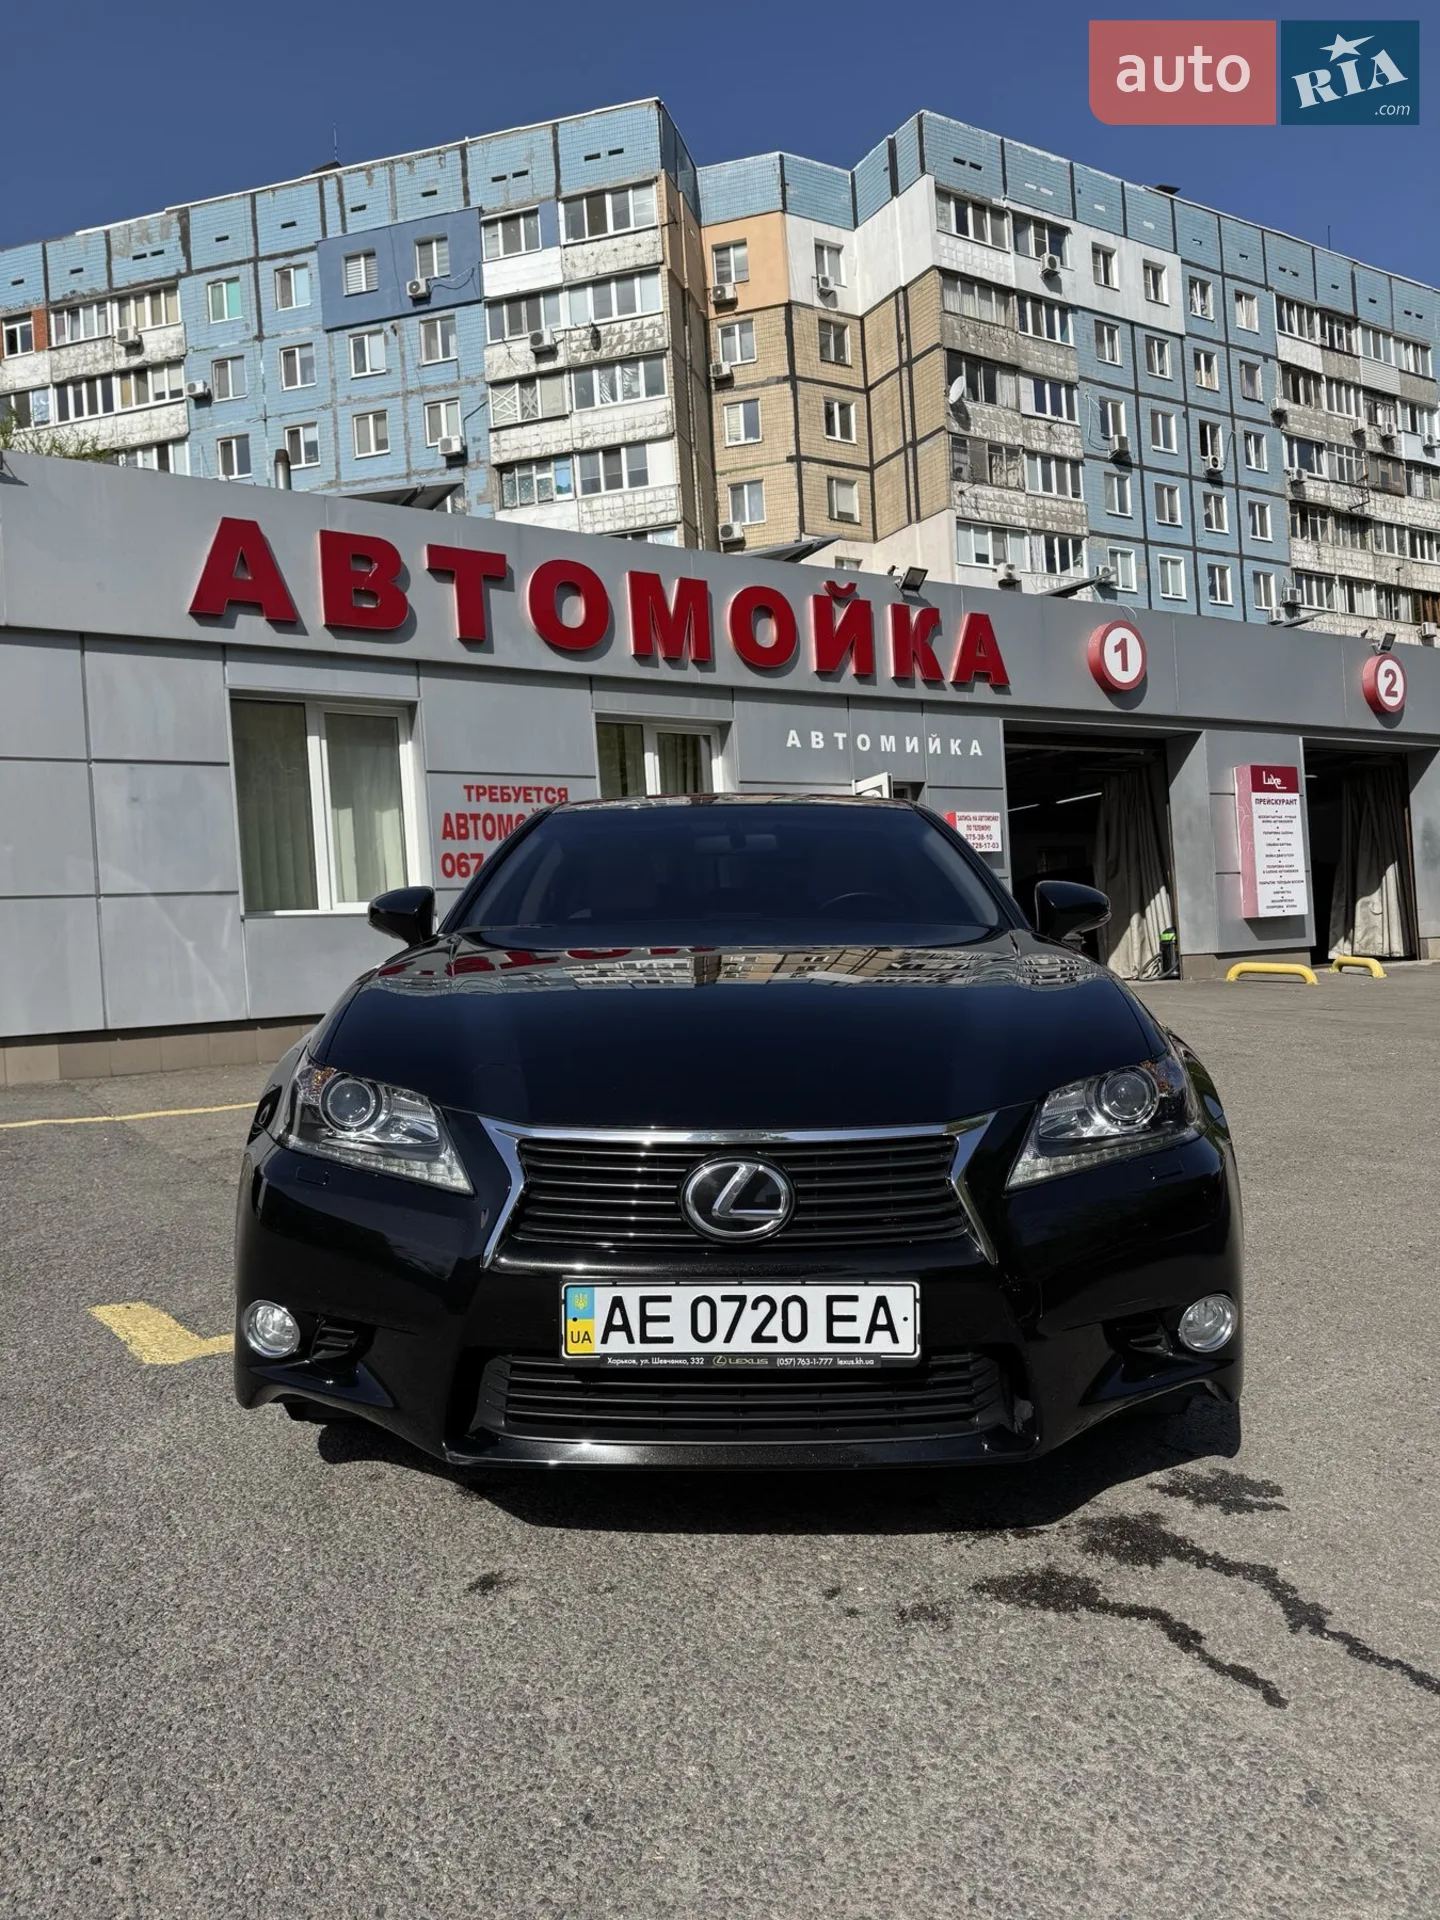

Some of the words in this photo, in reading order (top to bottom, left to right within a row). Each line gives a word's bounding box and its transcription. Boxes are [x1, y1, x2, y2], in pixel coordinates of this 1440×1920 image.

[189, 516, 1011, 687] АВТОМОЙКА
[1114, 637, 1129, 672] 1
[1383, 668, 1399, 698] 2
[786, 730, 983, 757] АВТОМИЙКА
[463, 785, 569, 804] ТРЕБУЕТСЯ
[1255, 797, 1298, 806] ПРЕЙСКУРАНТ
[442, 808, 539, 841] АВТОМ
[441, 852, 484, 878] 067
[600, 1294, 675, 1345] AE
[690, 1294, 808, 1345] 0720
[826, 1294, 900, 1345] EA
[570, 1331, 592, 1345] UA
[640, 1358, 650, 1366] ул.
[776, 1357, 796, 1367] (057)
[797, 1357, 833, 1365] 763-1-777
[837, 1357, 874, 1365] lexus.kh.ua
